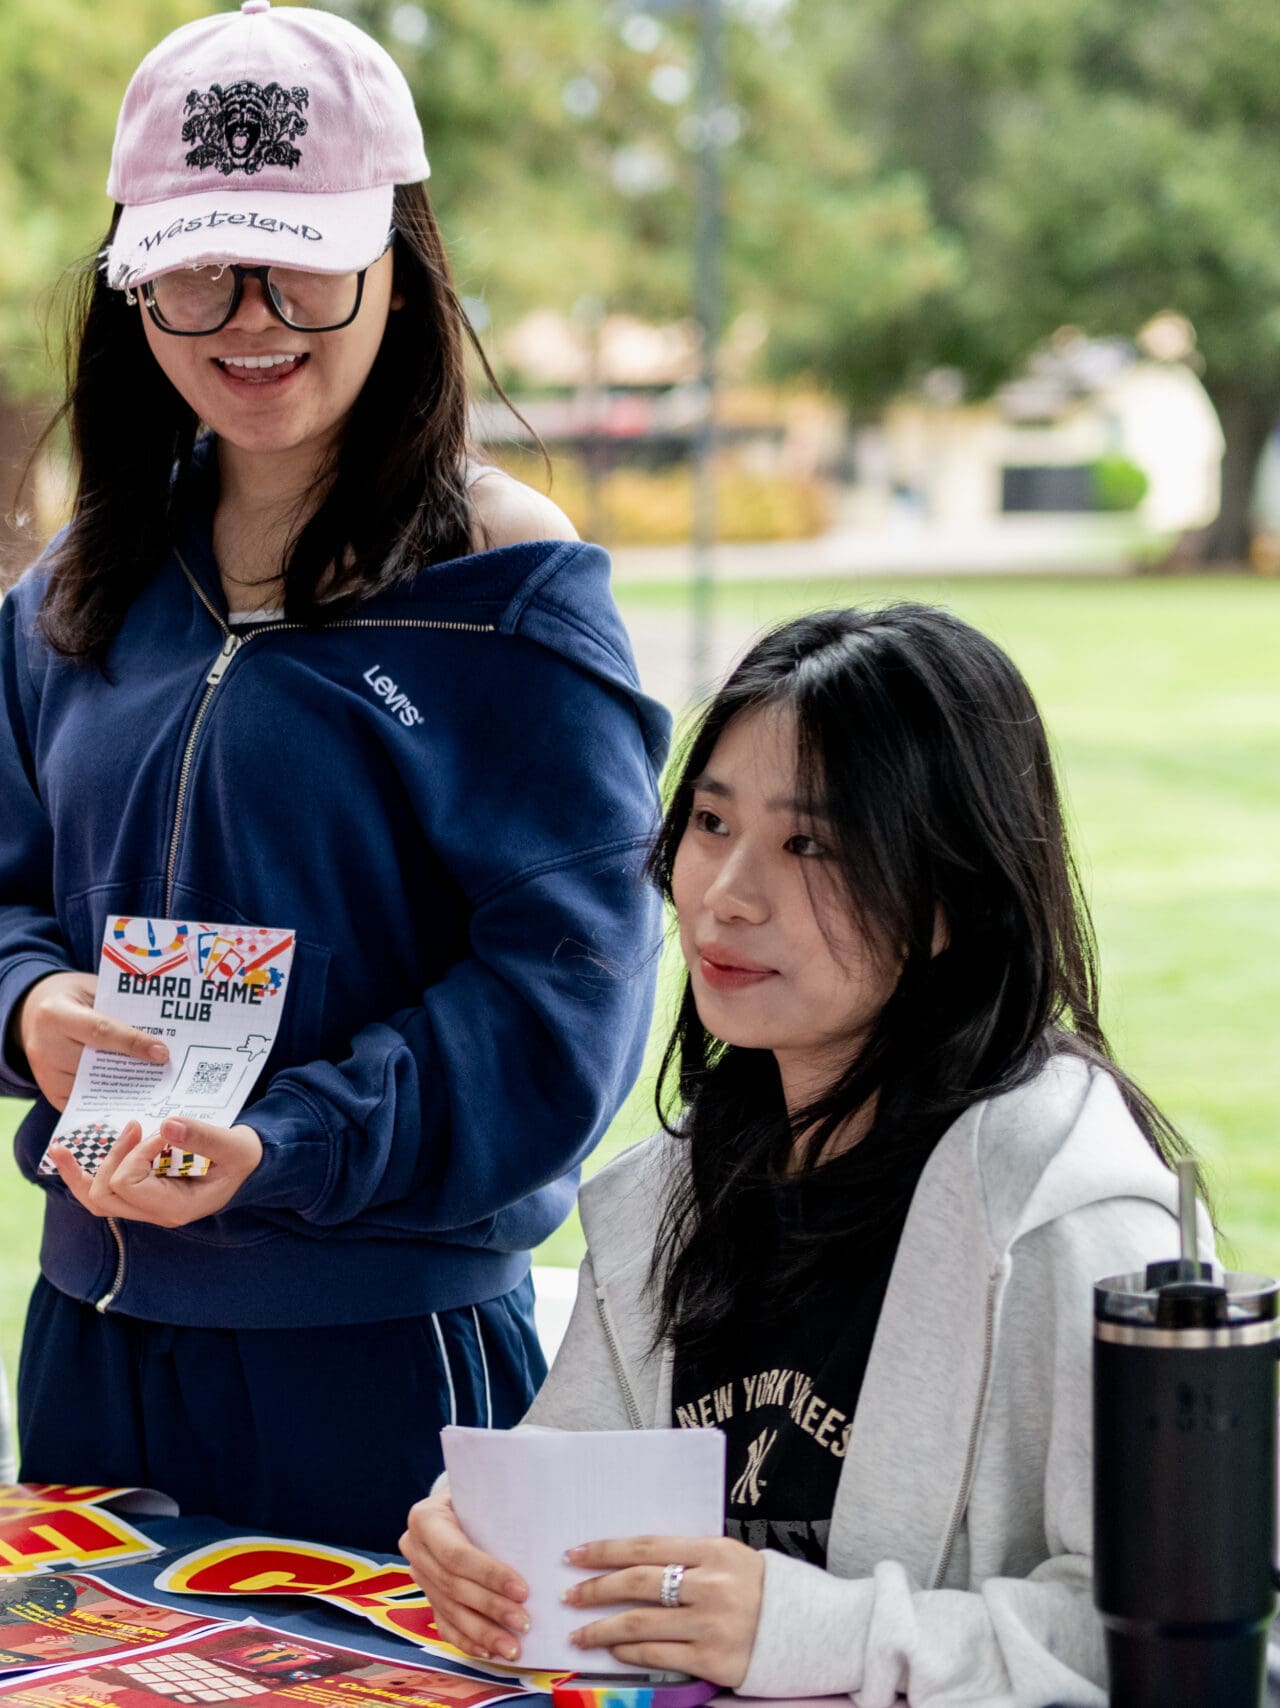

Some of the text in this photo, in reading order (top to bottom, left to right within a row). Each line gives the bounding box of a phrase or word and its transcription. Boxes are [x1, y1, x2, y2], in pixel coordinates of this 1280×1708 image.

[118, 973, 263, 1004] BOARD GAME
[160, 1000, 212, 1022] CLUB
[166, 1028, 176, 1037] TO
[675, 1382, 734, 1429] NEW
[743, 1369, 794, 1412] YORK
